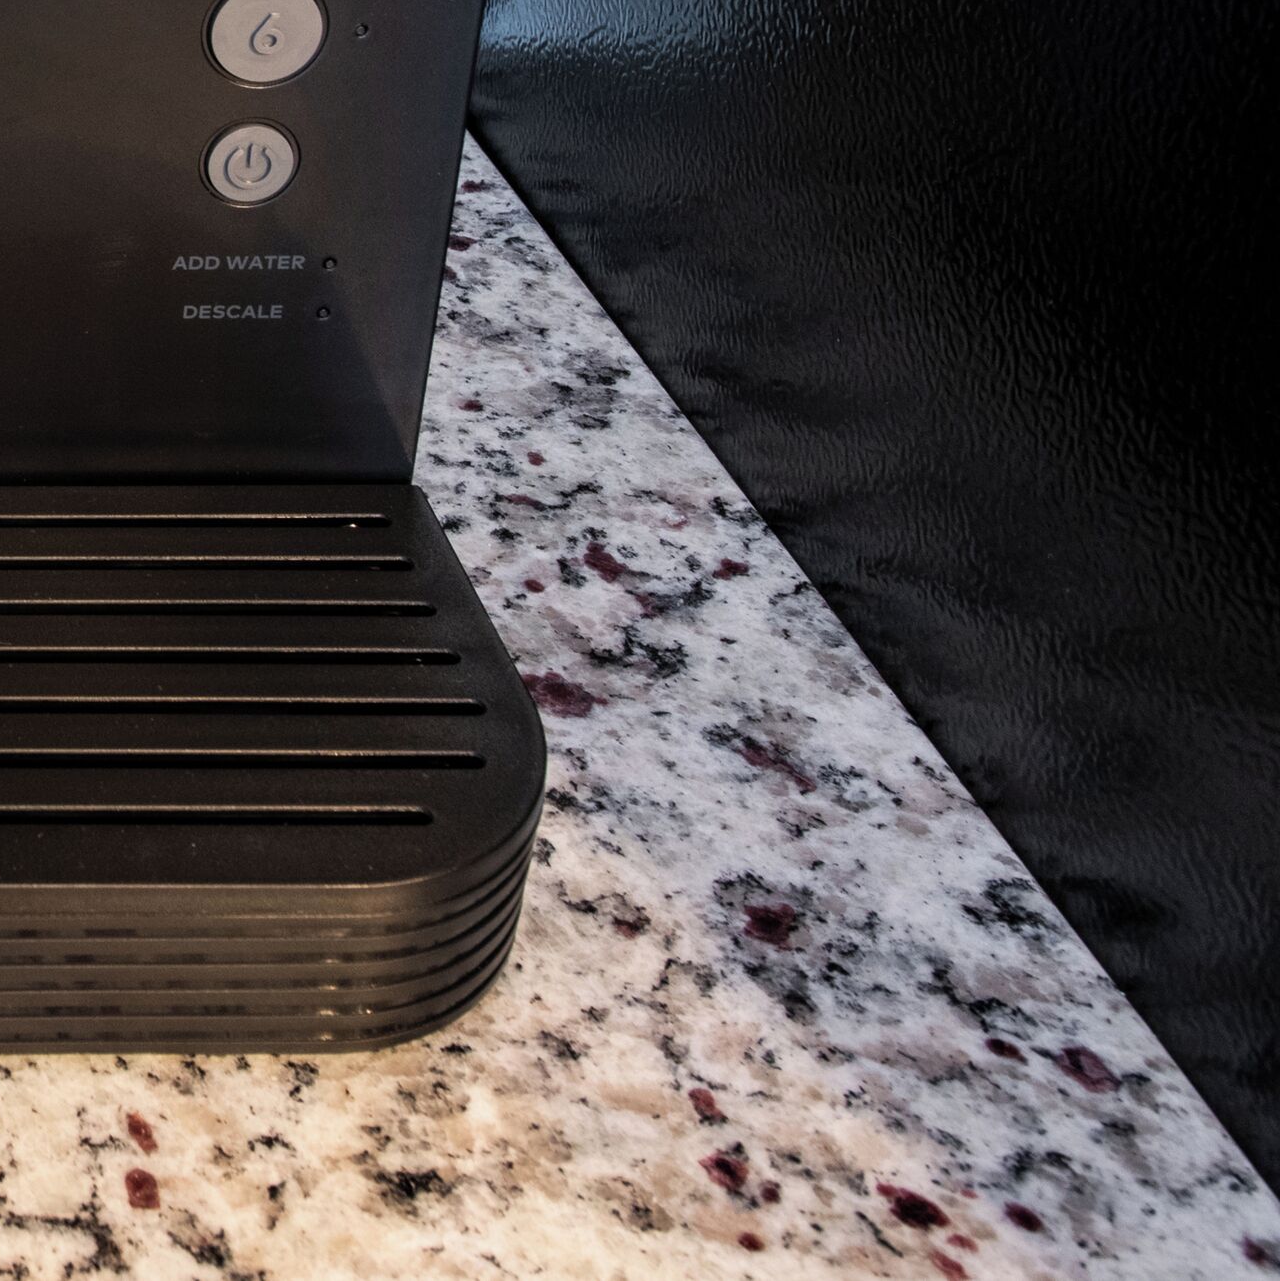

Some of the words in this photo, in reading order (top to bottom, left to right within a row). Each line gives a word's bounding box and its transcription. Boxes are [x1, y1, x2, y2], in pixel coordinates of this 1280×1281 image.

[249, 11, 285, 57] 6
[172, 256, 221, 272] ADD
[226, 255, 306, 271] WATER
[182, 305, 284, 320] DESCALE
